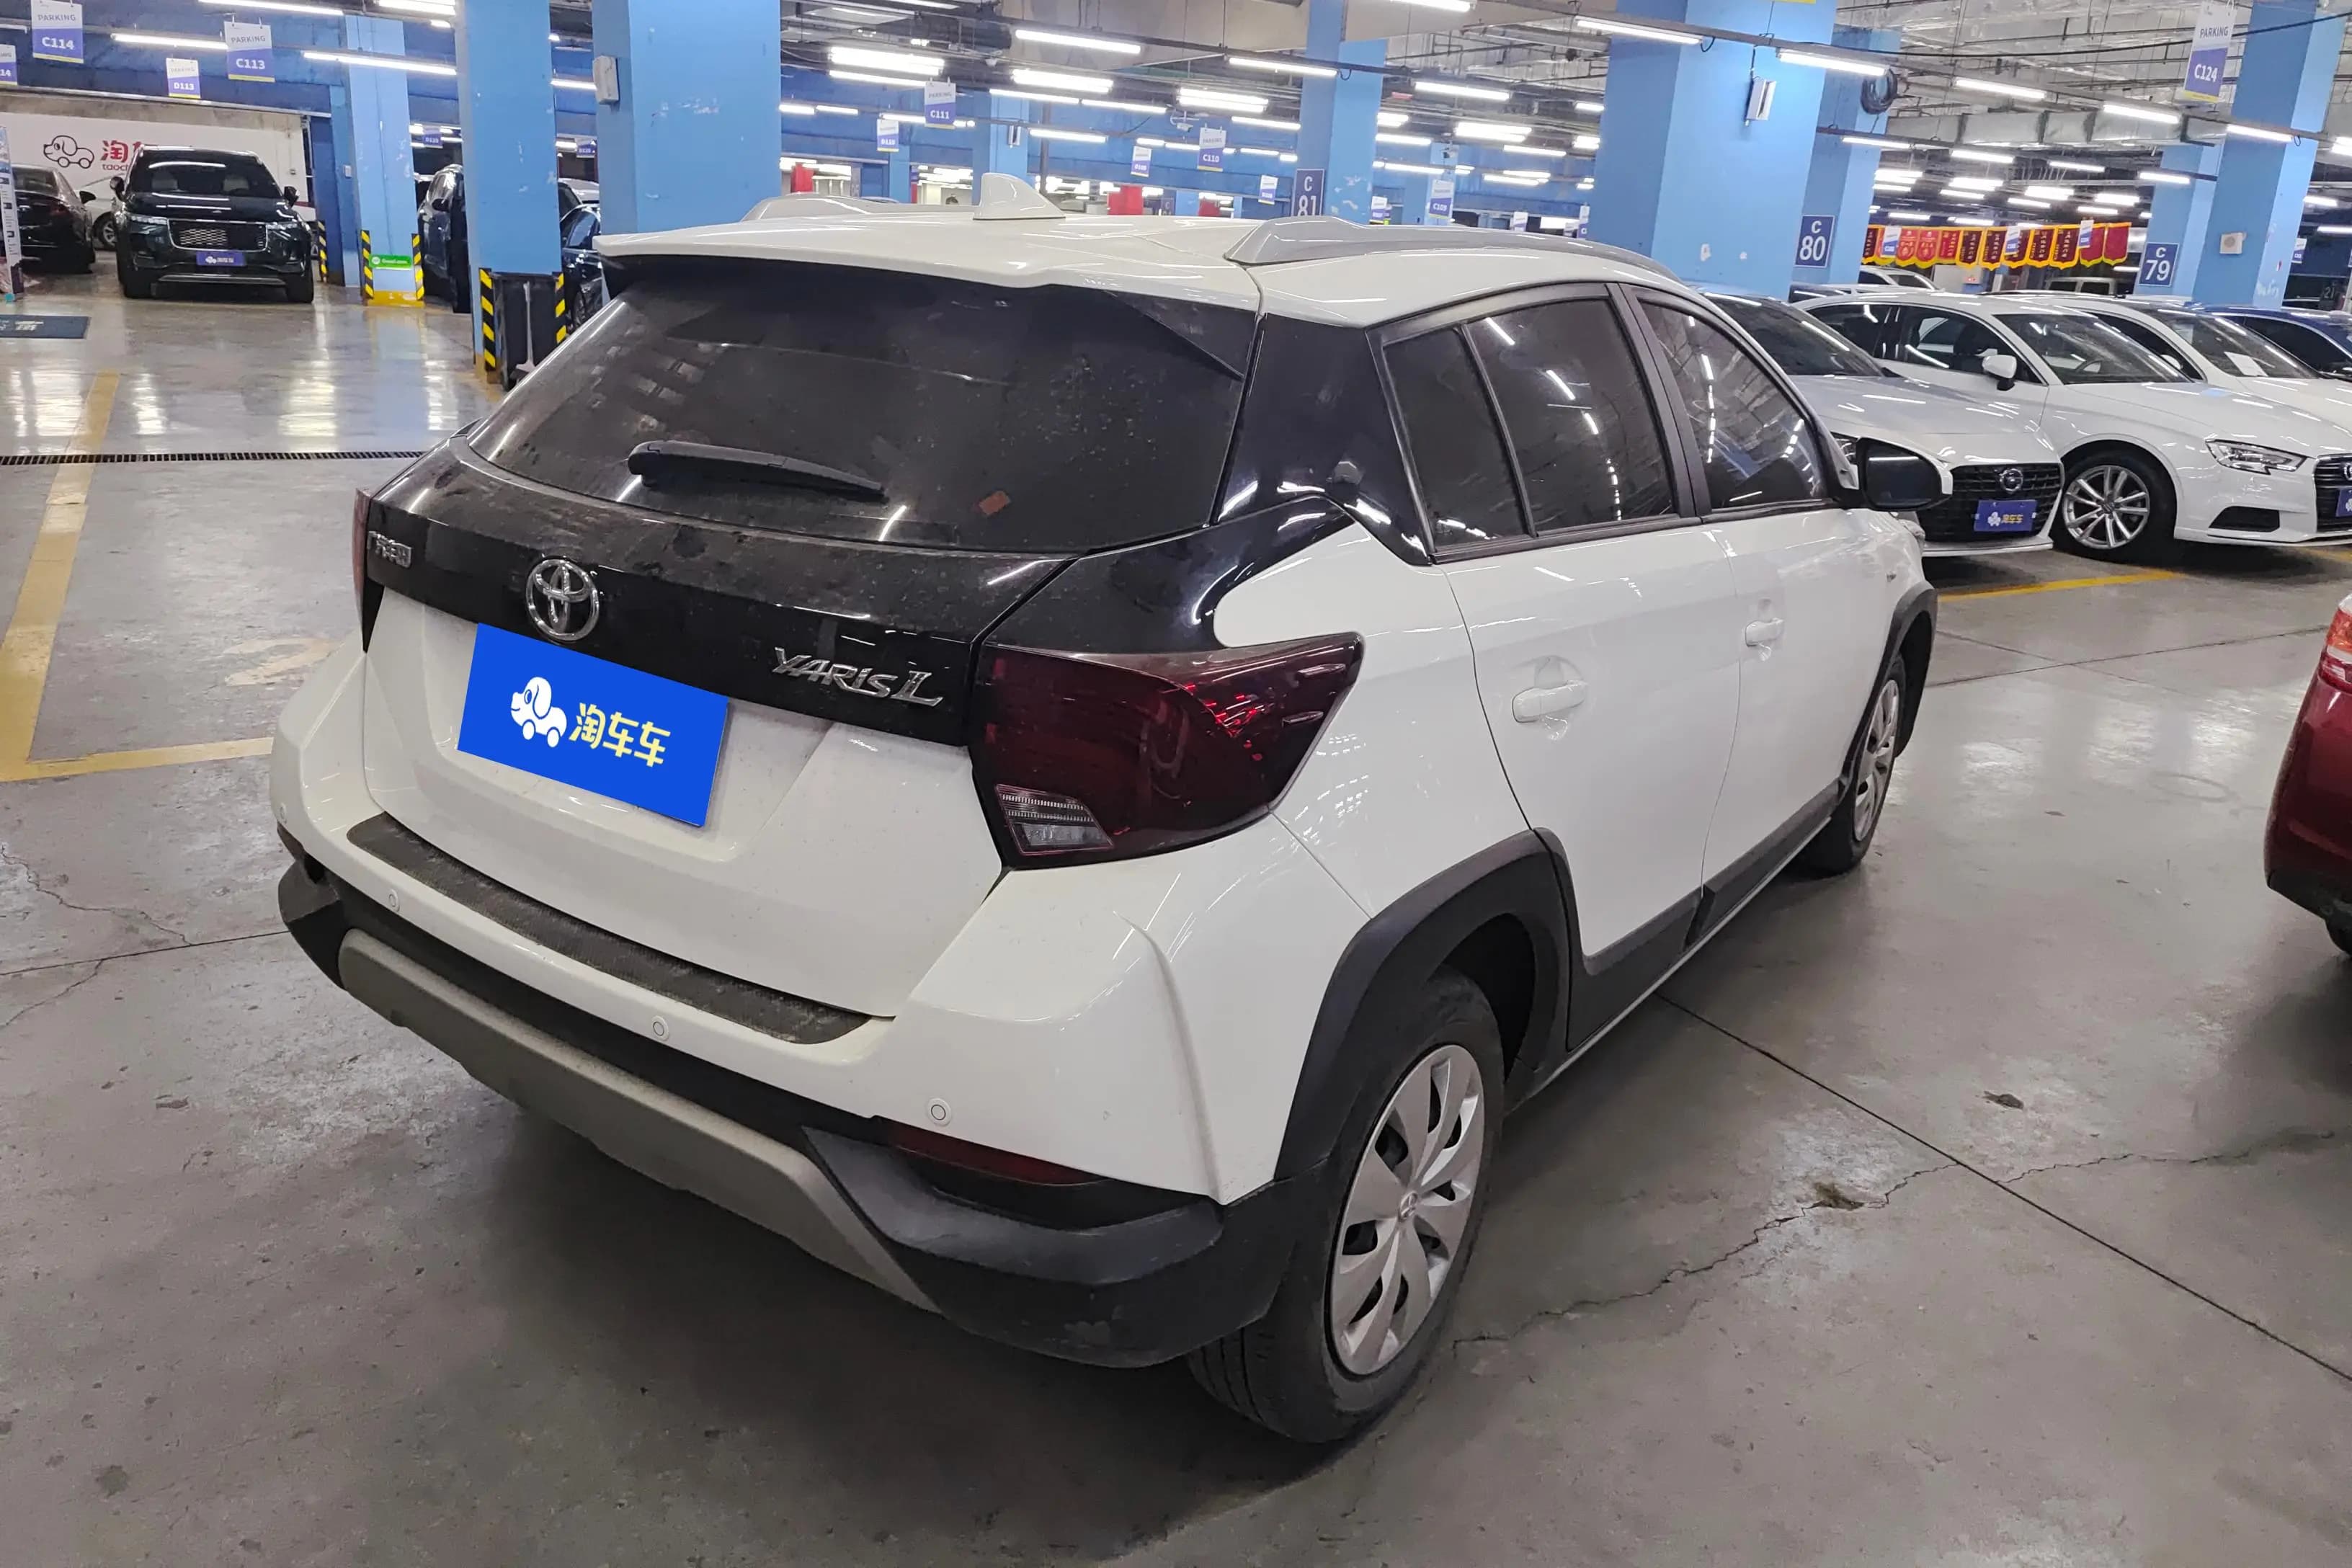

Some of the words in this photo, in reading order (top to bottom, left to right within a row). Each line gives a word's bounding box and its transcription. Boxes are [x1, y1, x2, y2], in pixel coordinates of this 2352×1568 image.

[2199, 26, 2229, 39] PARKING
[42, 37, 74, 50] C114
[236, 58, 266, 70] C113
[2194, 63, 2218, 83] C124
[174, 82, 195, 91] D113
[930, 110, 950, 120] C111
[1203, 154, 1219, 163] C110
[1304, 176, 1313, 192] C
[1298, 195, 1317, 216] 81
[1811, 220, 1822, 233] C
[1799, 236, 1826, 261] 80
[2155, 247, 2166, 258] C
[2145, 259, 2170, 281] 79
